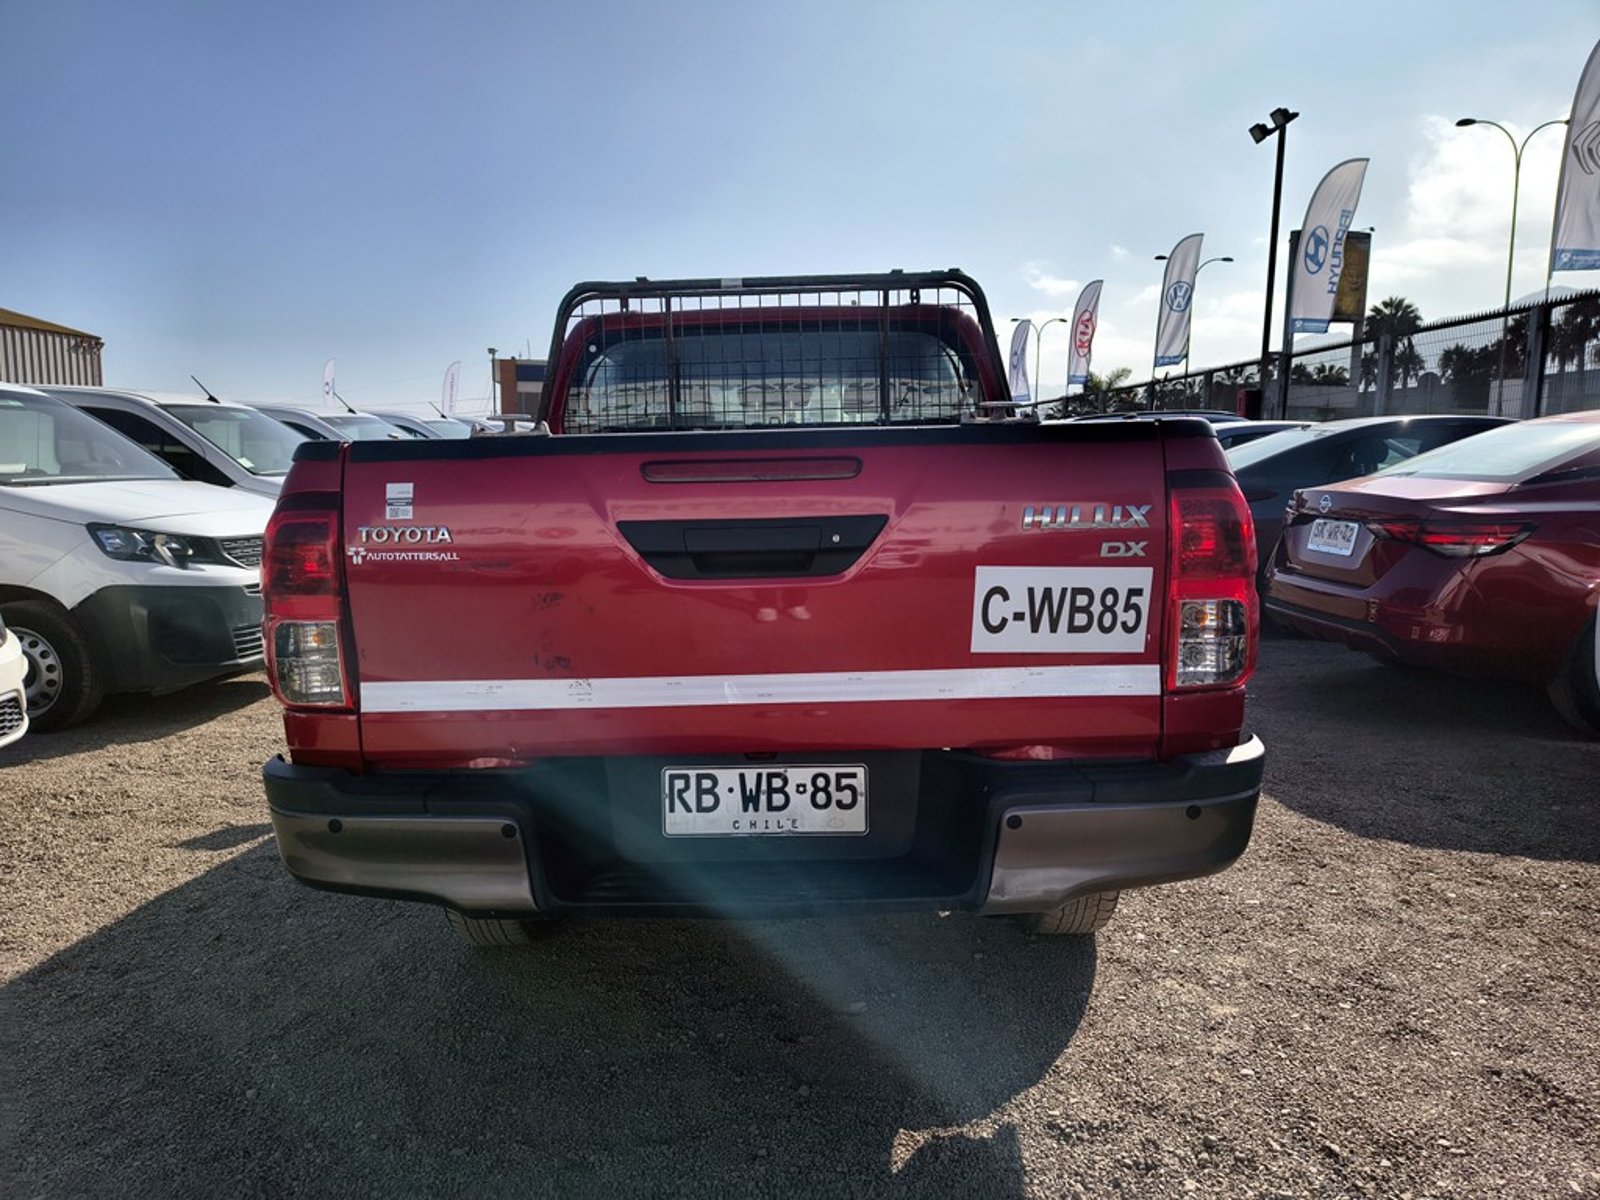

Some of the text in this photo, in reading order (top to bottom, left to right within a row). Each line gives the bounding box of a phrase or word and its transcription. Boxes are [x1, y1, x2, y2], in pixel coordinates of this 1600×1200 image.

[1023, 505, 1153, 529] HILUX
[357, 526, 453, 544] TOYOTA
[366, 552, 460, 561] AUTOTATTERSALL
[1100, 541, 1149, 557] DX
[981, 585, 1144, 634] C-WB85
[732, 818, 798, 830] CHILE
